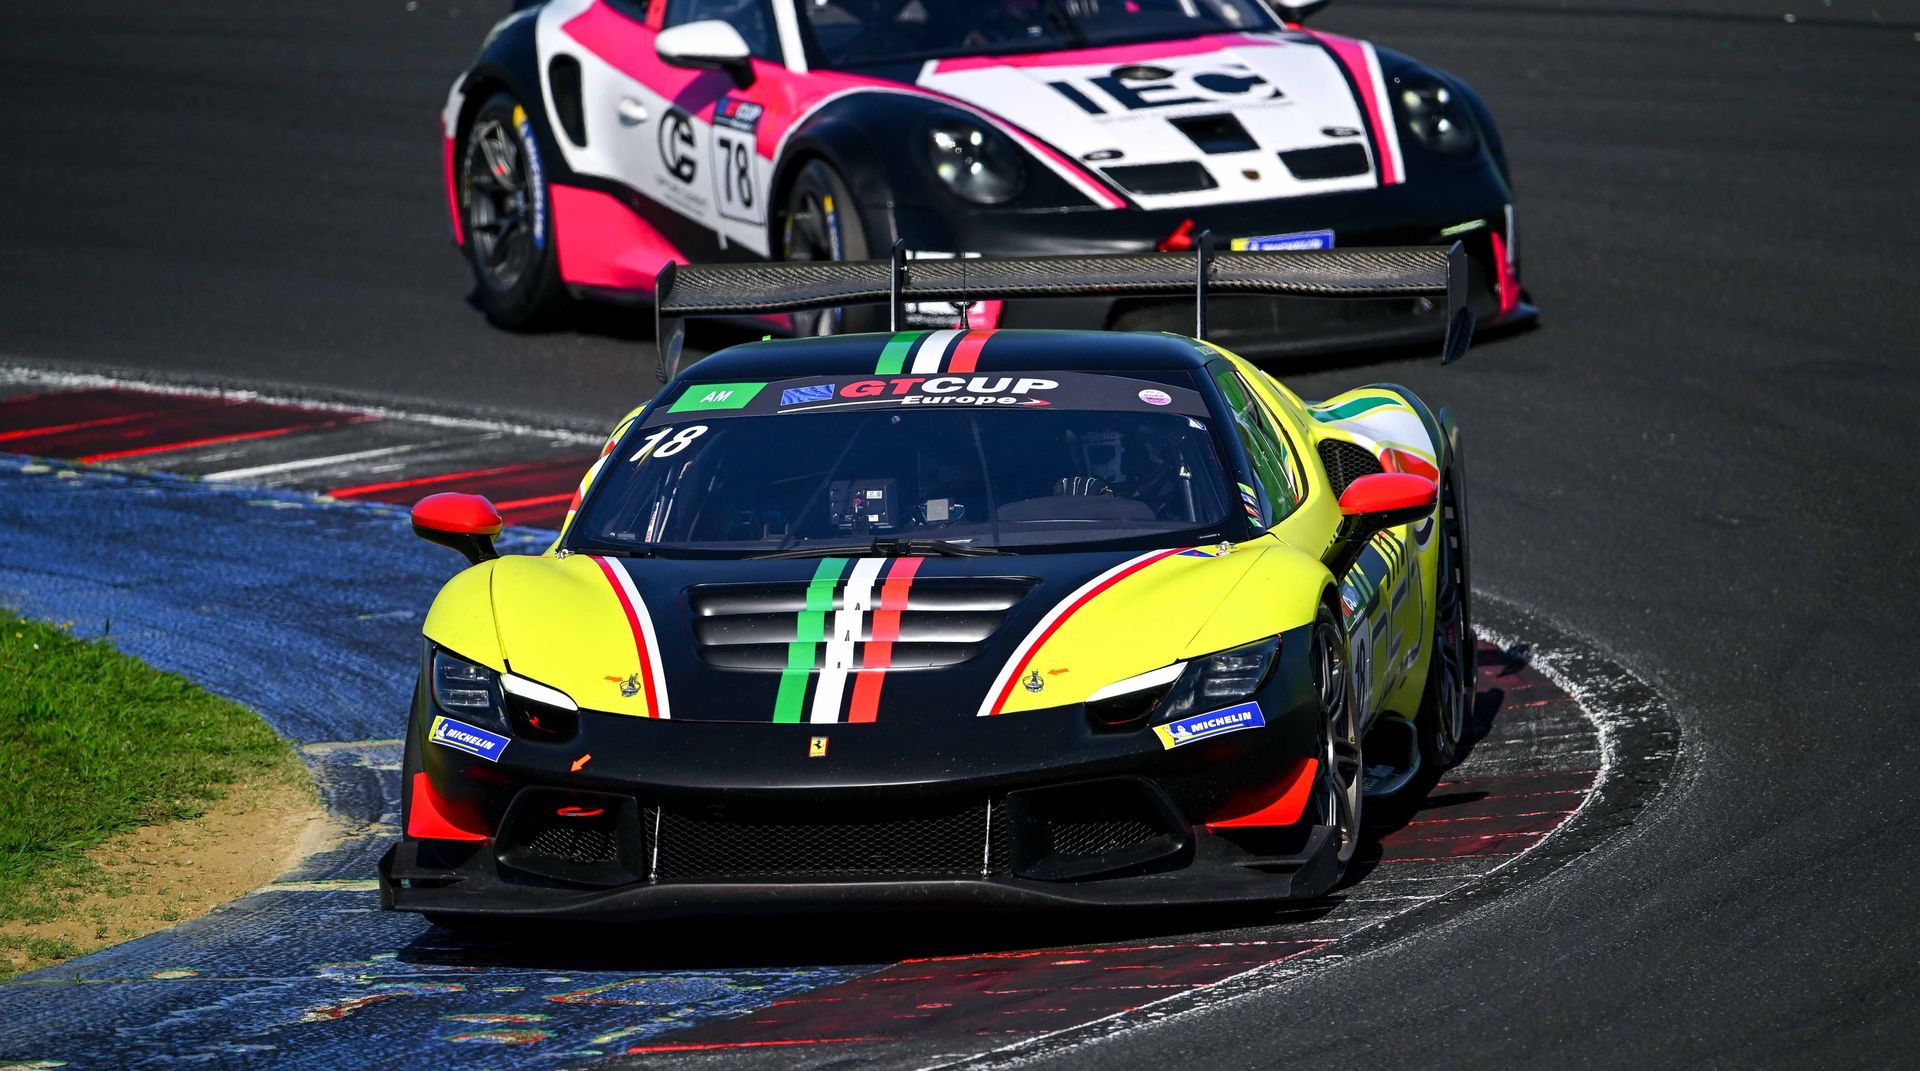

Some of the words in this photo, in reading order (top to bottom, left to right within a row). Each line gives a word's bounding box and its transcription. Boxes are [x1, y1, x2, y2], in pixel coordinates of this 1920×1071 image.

[718, 137, 753, 208] 78
[699, 390, 734, 403] AM
[839, 376, 1059, 399] GTCUP
[901, 395, 1017, 406] Europe
[628, 425, 709, 462] 18
[1190, 711, 1252, 733] MICHELIN
[446, 728, 495, 750] MICHELIN
